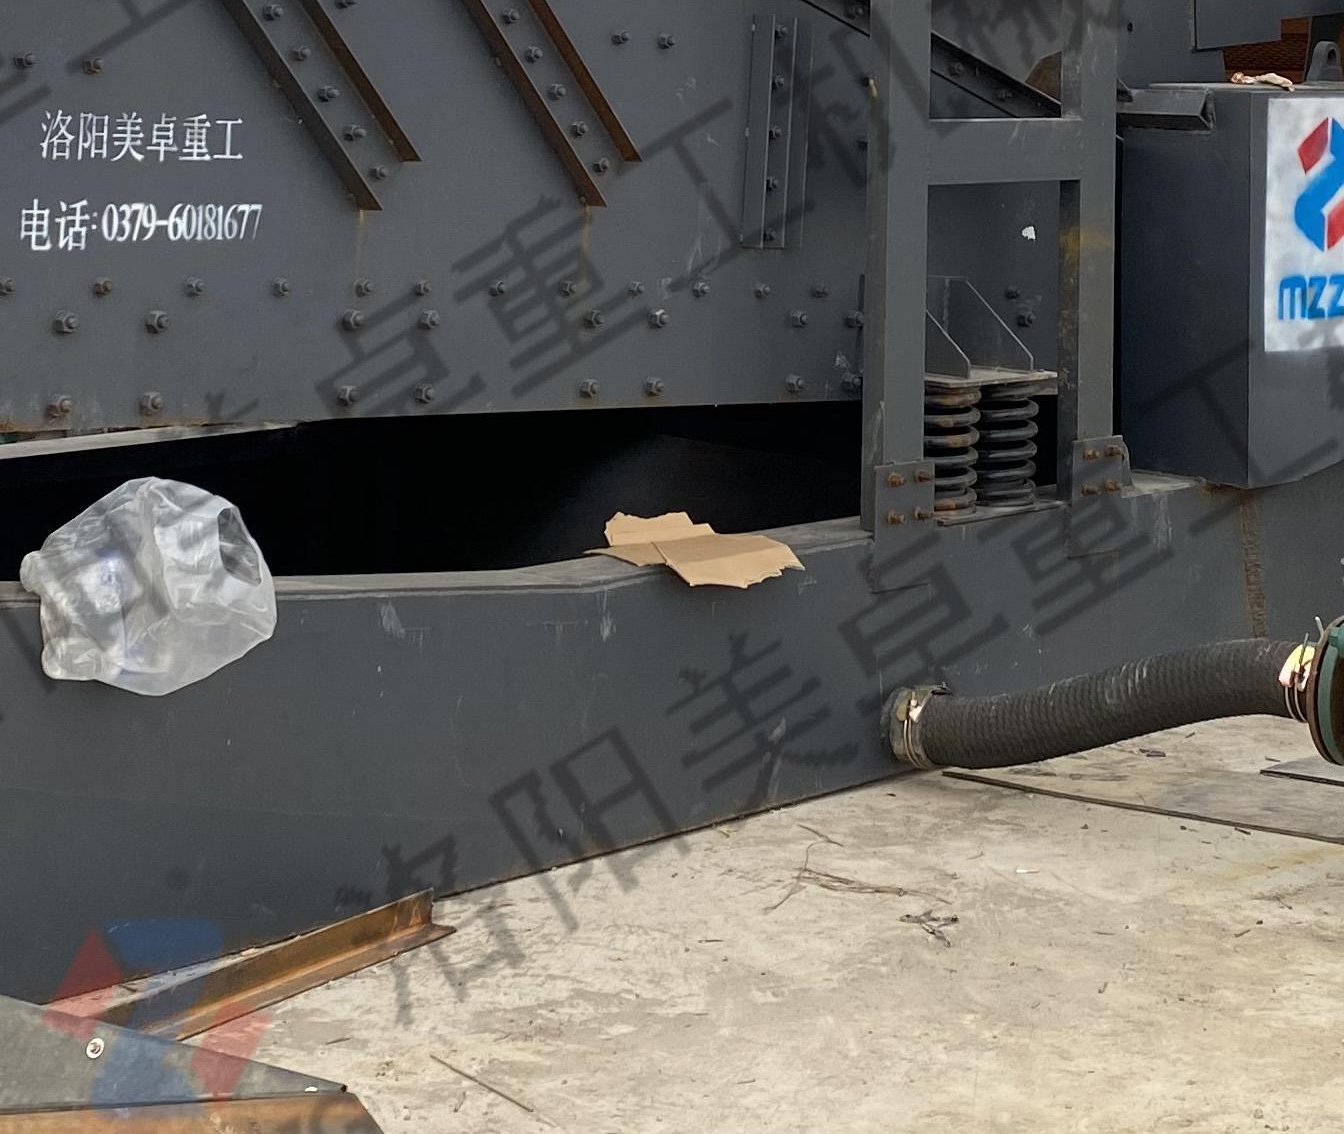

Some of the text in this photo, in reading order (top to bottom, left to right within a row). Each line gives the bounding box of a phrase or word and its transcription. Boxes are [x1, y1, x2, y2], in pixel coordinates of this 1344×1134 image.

[40, 109, 243, 162] 洛阳美卓重工
